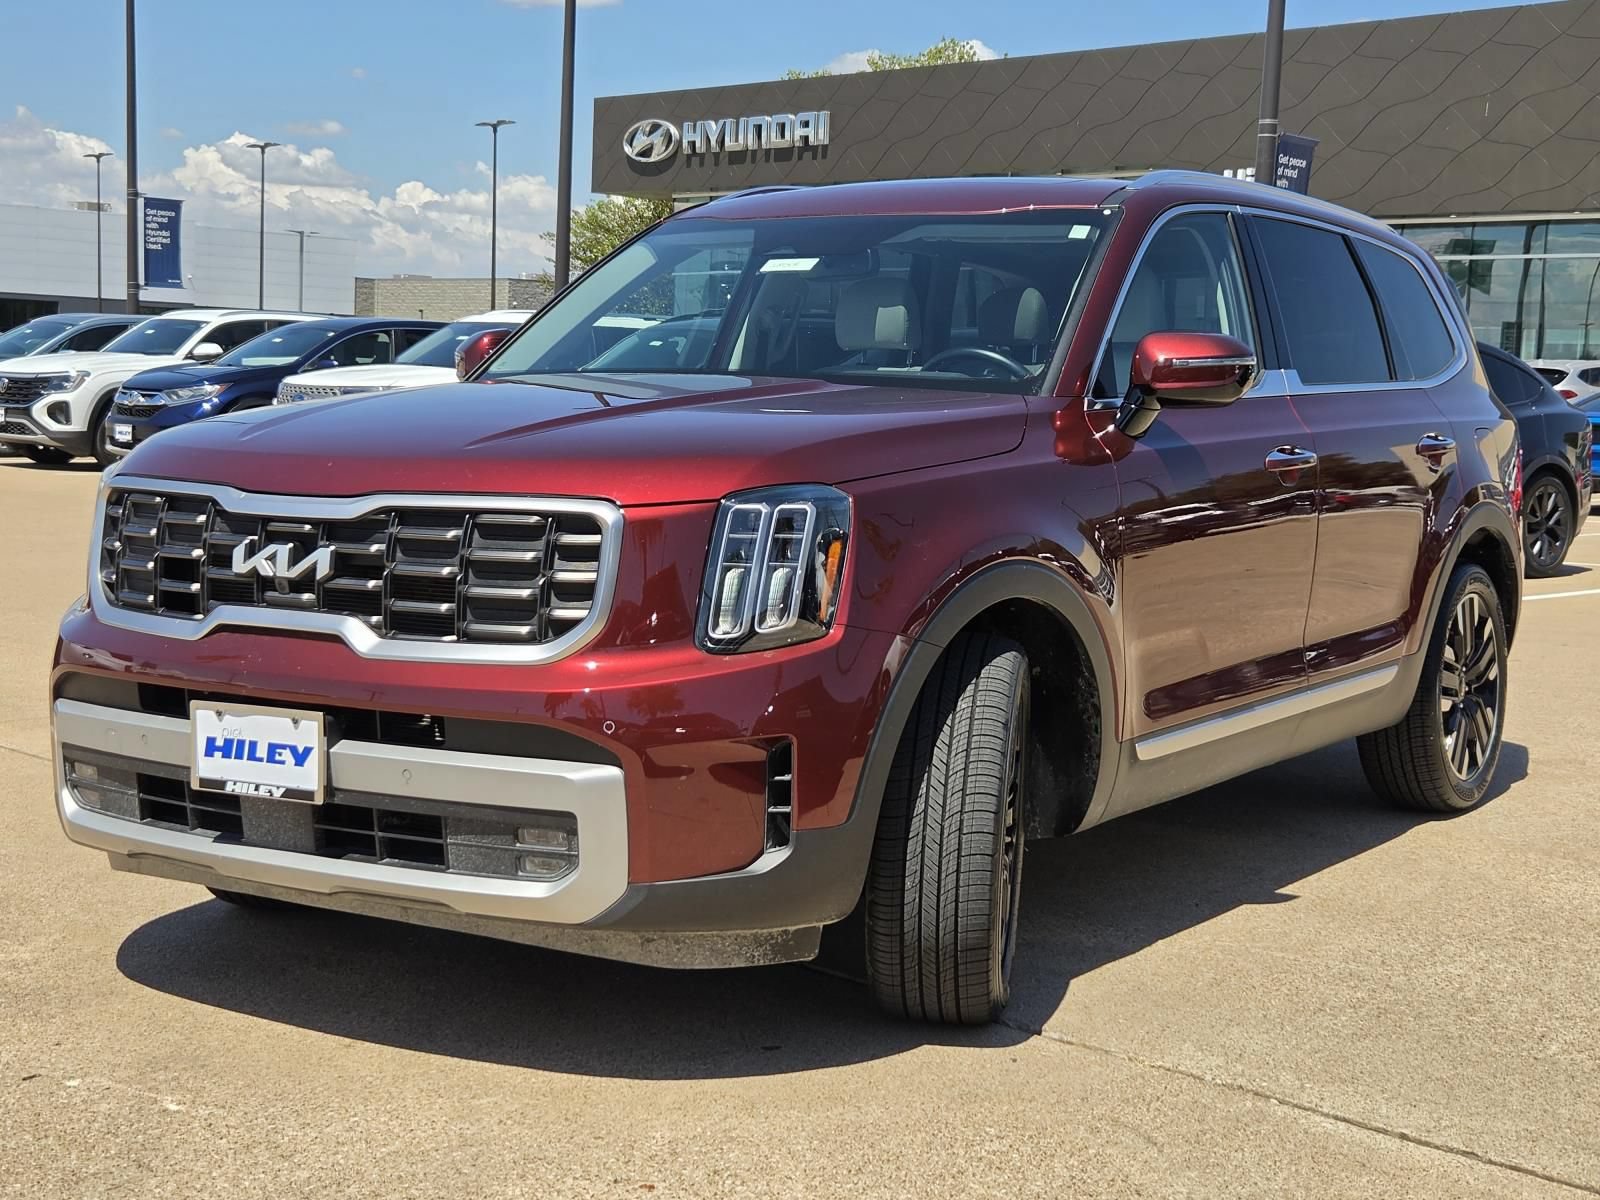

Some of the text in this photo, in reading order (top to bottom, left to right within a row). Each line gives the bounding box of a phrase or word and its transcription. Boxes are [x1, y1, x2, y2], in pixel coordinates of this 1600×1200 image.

[683, 111, 830, 154] HYUNDAI
[1278, 154, 1307, 168] Get peace
[1277, 166, 1298, 178] of mind
[1276, 178, 1288, 188] with
[157, 209, 176, 217] peace
[145, 229, 170, 237] Hyundai
[204, 736, 314, 767] HILEY
[225, 781, 287, 797] HILEY
